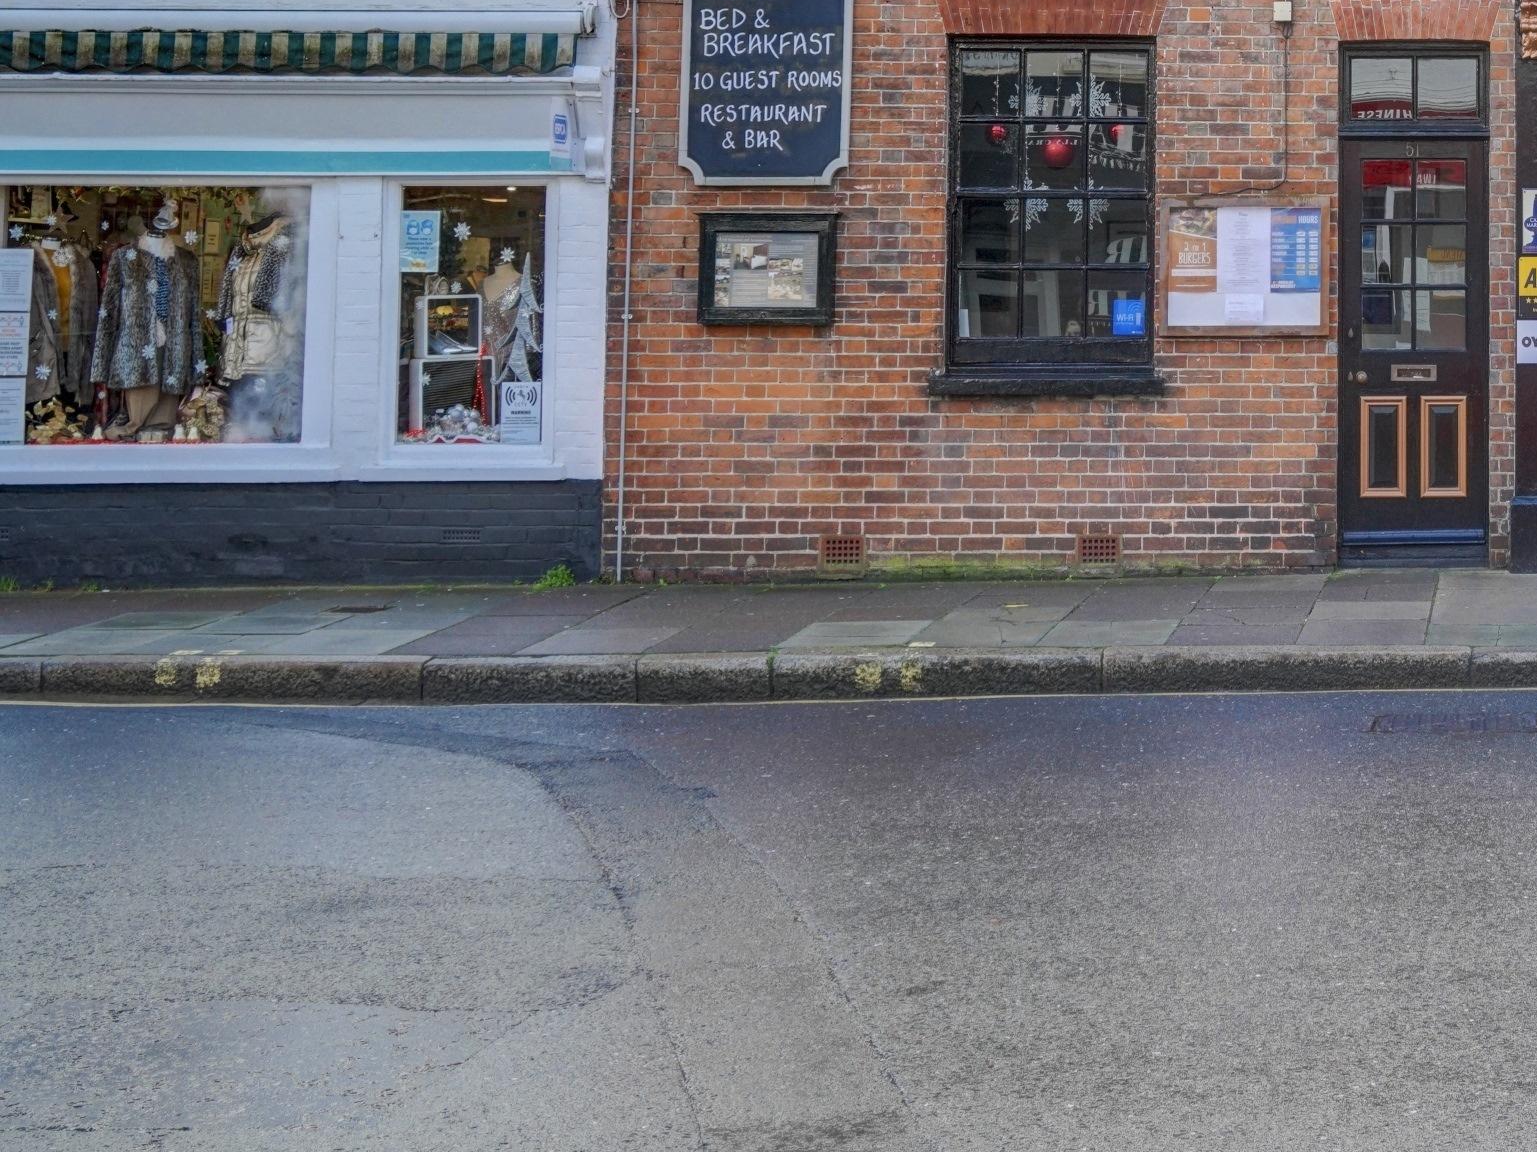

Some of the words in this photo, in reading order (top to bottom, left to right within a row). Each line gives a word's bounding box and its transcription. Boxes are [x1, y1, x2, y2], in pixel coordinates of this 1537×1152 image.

[700, 8, 746, 30] BED
[754, 8, 770, 28] &
[703, 32, 835, 59] BREAKFAST
[694, 72, 713, 90] 10
[720, 71, 780, 91] GUEST
[787, 70, 842, 91] ROOMS
[700, 103, 827, 126] RESTAURANT
[721, 130, 736, 149] &
[744, 129, 783, 150] BAR
[1405, 142, 1420, 157] 51
[1298, 215, 1318, 224] HOURS
[1178, 251, 1211, 265] BURGERS
